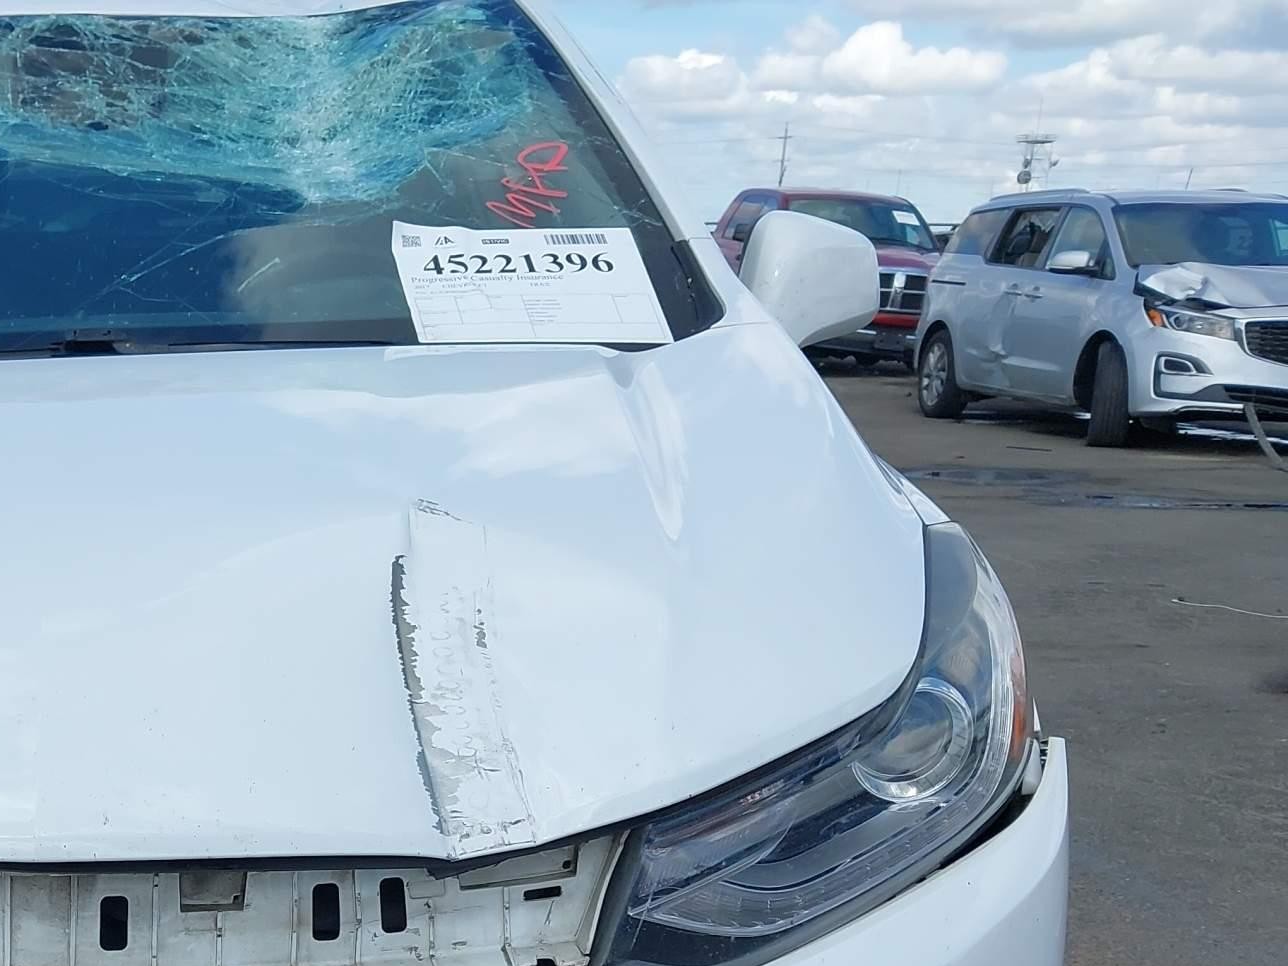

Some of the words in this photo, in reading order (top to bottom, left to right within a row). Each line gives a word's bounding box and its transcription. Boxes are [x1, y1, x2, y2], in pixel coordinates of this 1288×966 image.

[423, 252, 614, 275] 45221396
[411, 273, 469, 284] Progressive
[470, 274, 513, 282] Casualty
